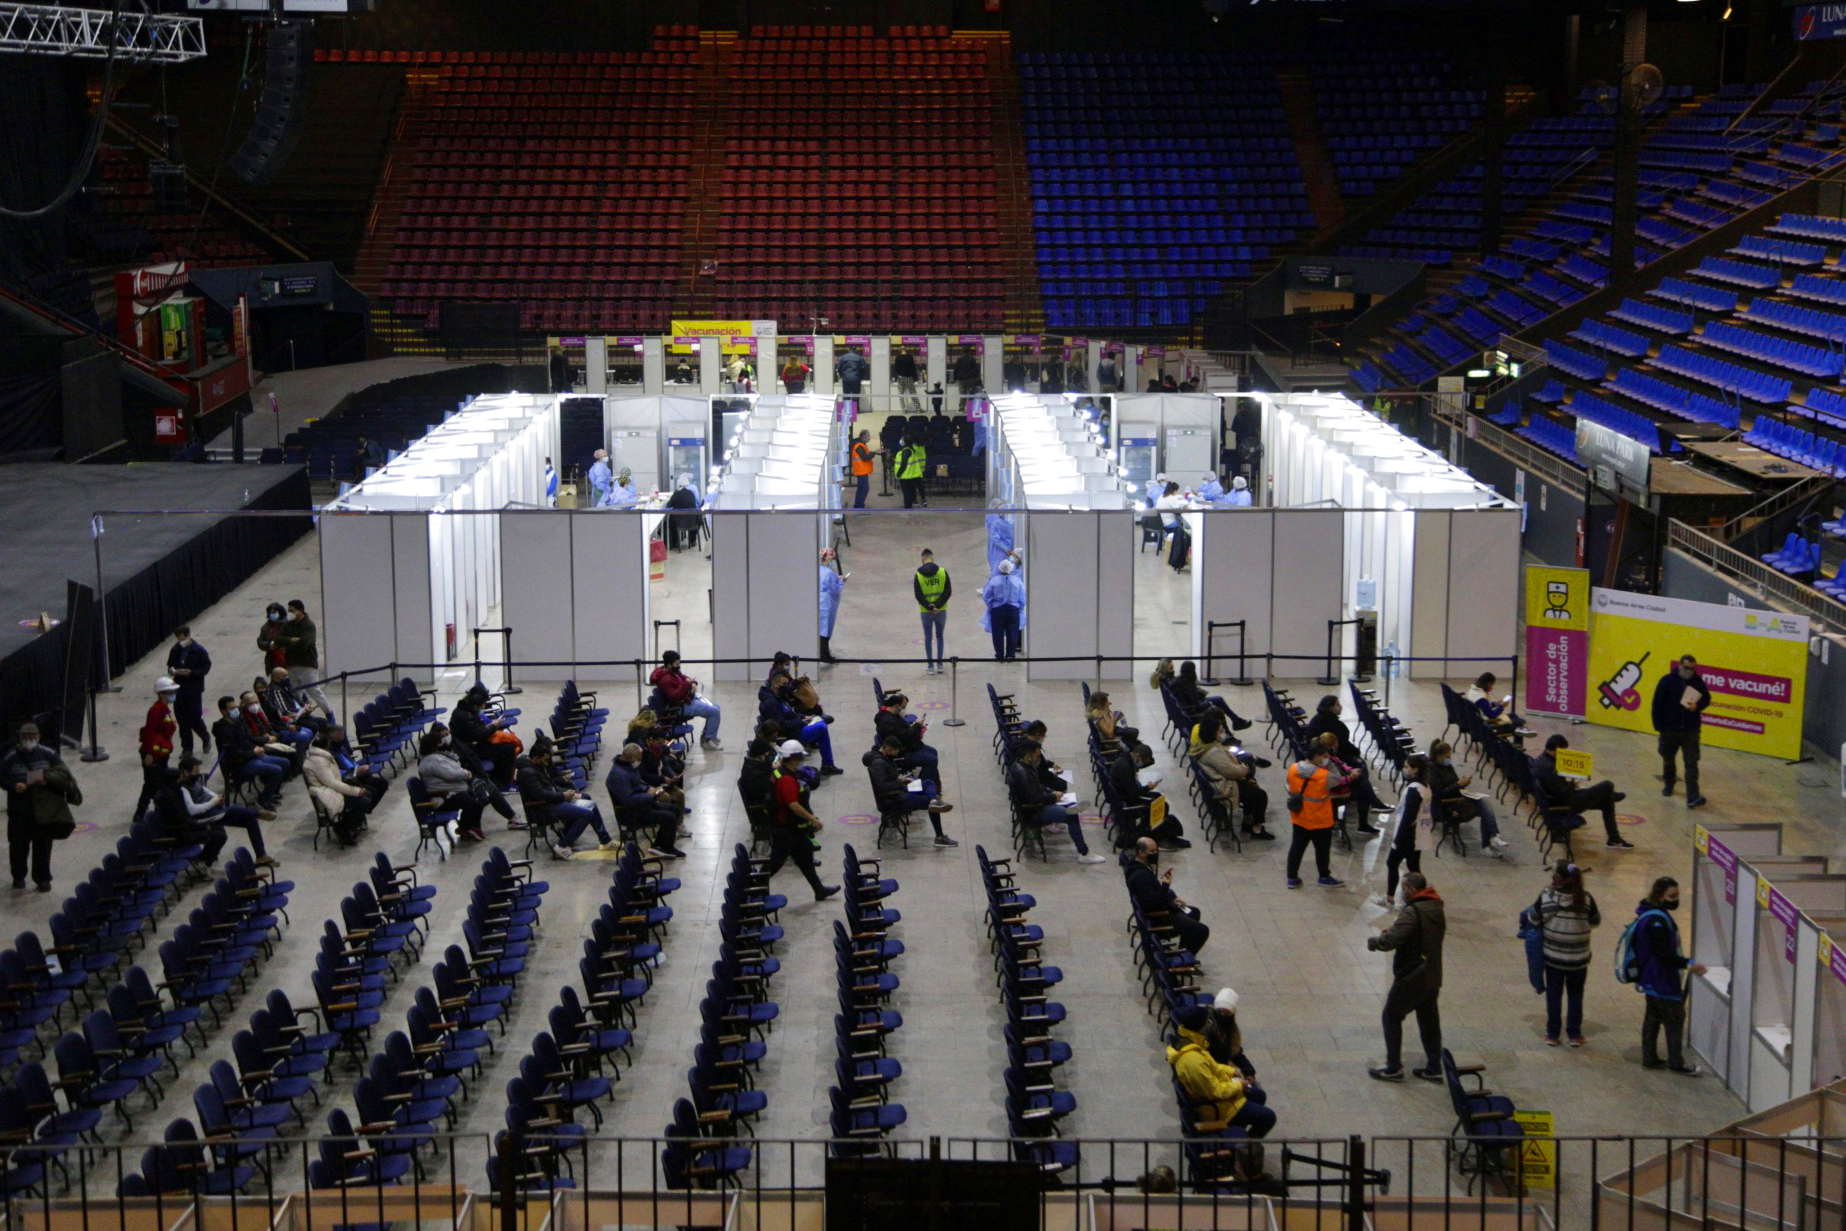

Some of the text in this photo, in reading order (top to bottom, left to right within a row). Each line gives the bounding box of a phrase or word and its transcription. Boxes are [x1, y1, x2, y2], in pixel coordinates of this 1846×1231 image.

[684, 326, 742, 336] Vacunación
[1596, 431, 1615, 453] LUNA
[1616, 440, 1635, 462] PARK
[1545, 642, 1557, 702] Sector de
[1557, 635, 1568, 711] observación
[1702, 673, 1786, 697] me vacuné!
[1747, 706, 1784, 718] COVID-19
[1562, 758, 1585, 769] 10:15
[1726, 878, 1735, 896] 23
